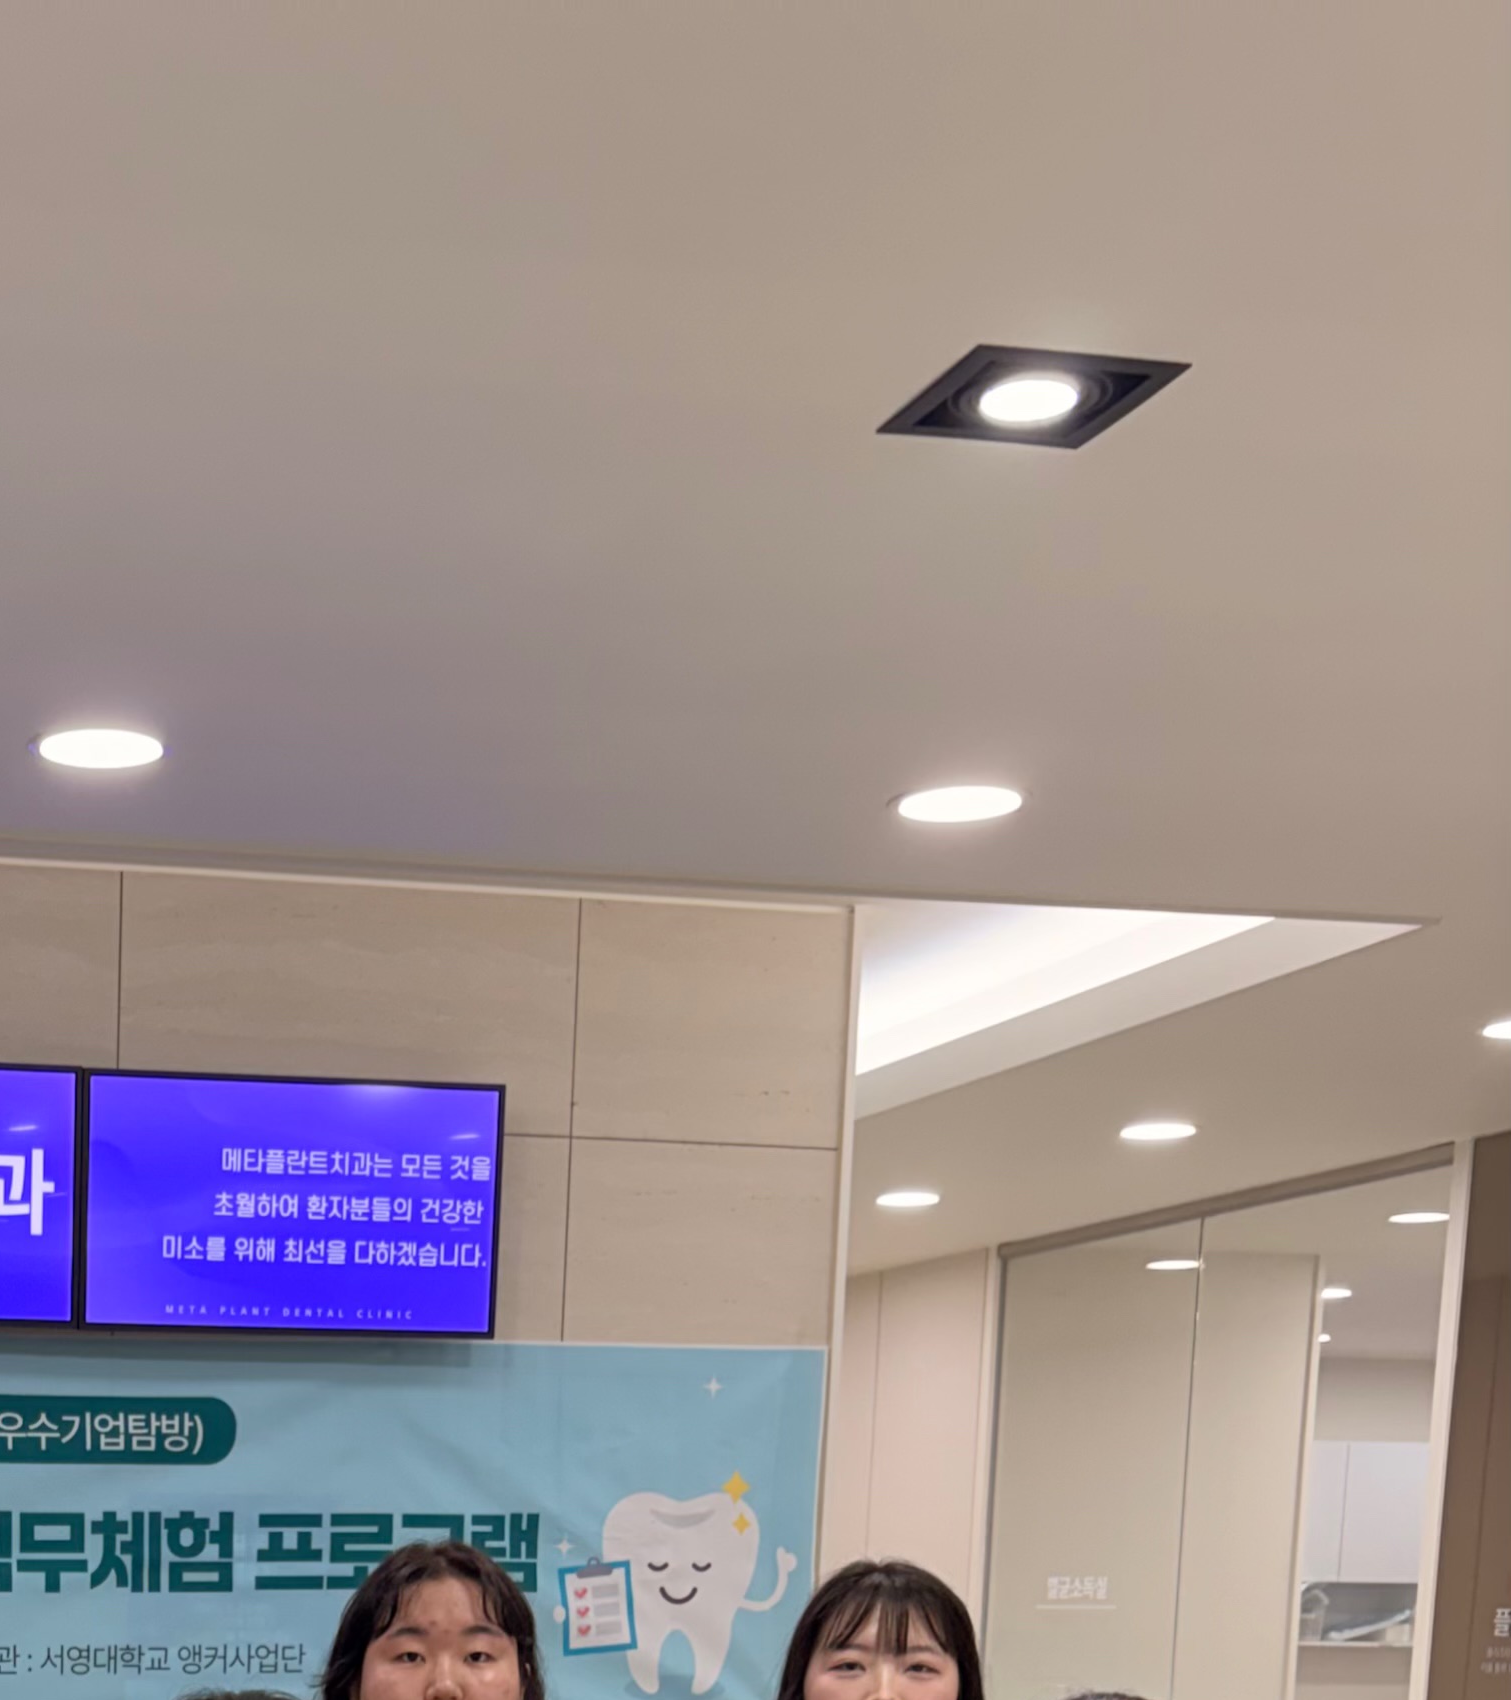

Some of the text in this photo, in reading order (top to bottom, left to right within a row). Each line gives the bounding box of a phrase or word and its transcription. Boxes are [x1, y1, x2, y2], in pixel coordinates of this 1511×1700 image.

[221, 1147, 491, 1182] 메타플란트치과는 모든 것을
[214, 1192, 483, 1225] 초월하여 환자분들의 건강한
[162, 1235, 487, 1269] 미소를 위해 최선을 다하겠습니다.
[165, 1304, 413, 1320] META PLANT DENTAL CLINIC
[40, 1643, 171, 1676] 서영대학교
[177, 1643, 306, 1675] 앵커사업단
